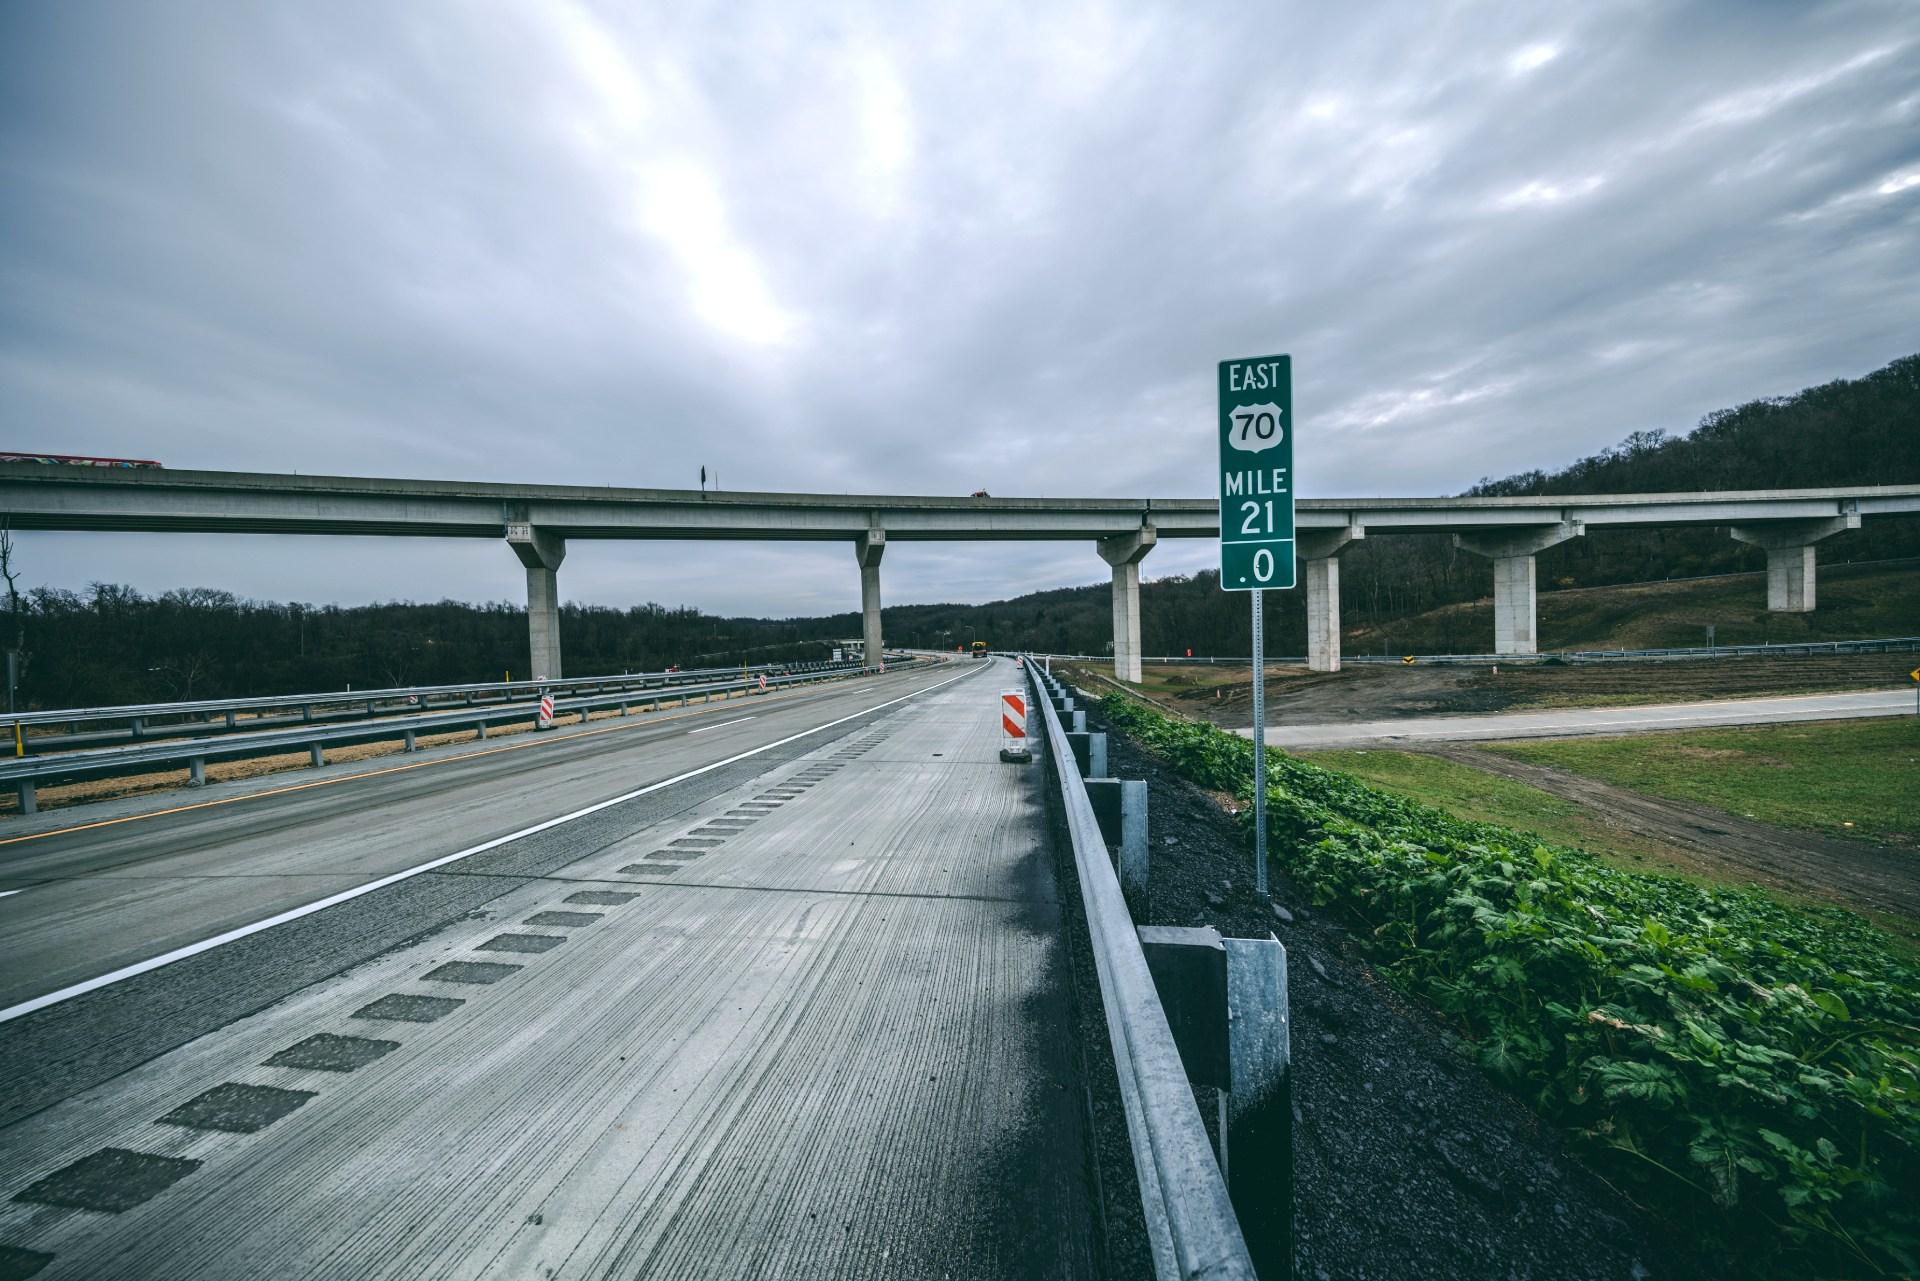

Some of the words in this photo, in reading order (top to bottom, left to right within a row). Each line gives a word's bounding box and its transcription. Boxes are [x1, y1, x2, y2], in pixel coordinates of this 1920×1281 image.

[1229, 363, 1280, 391] EAST
[1235, 412, 1275, 441] 70
[1225, 468, 1287, 496] MILE
[1240, 500, 1273, 534] 21
